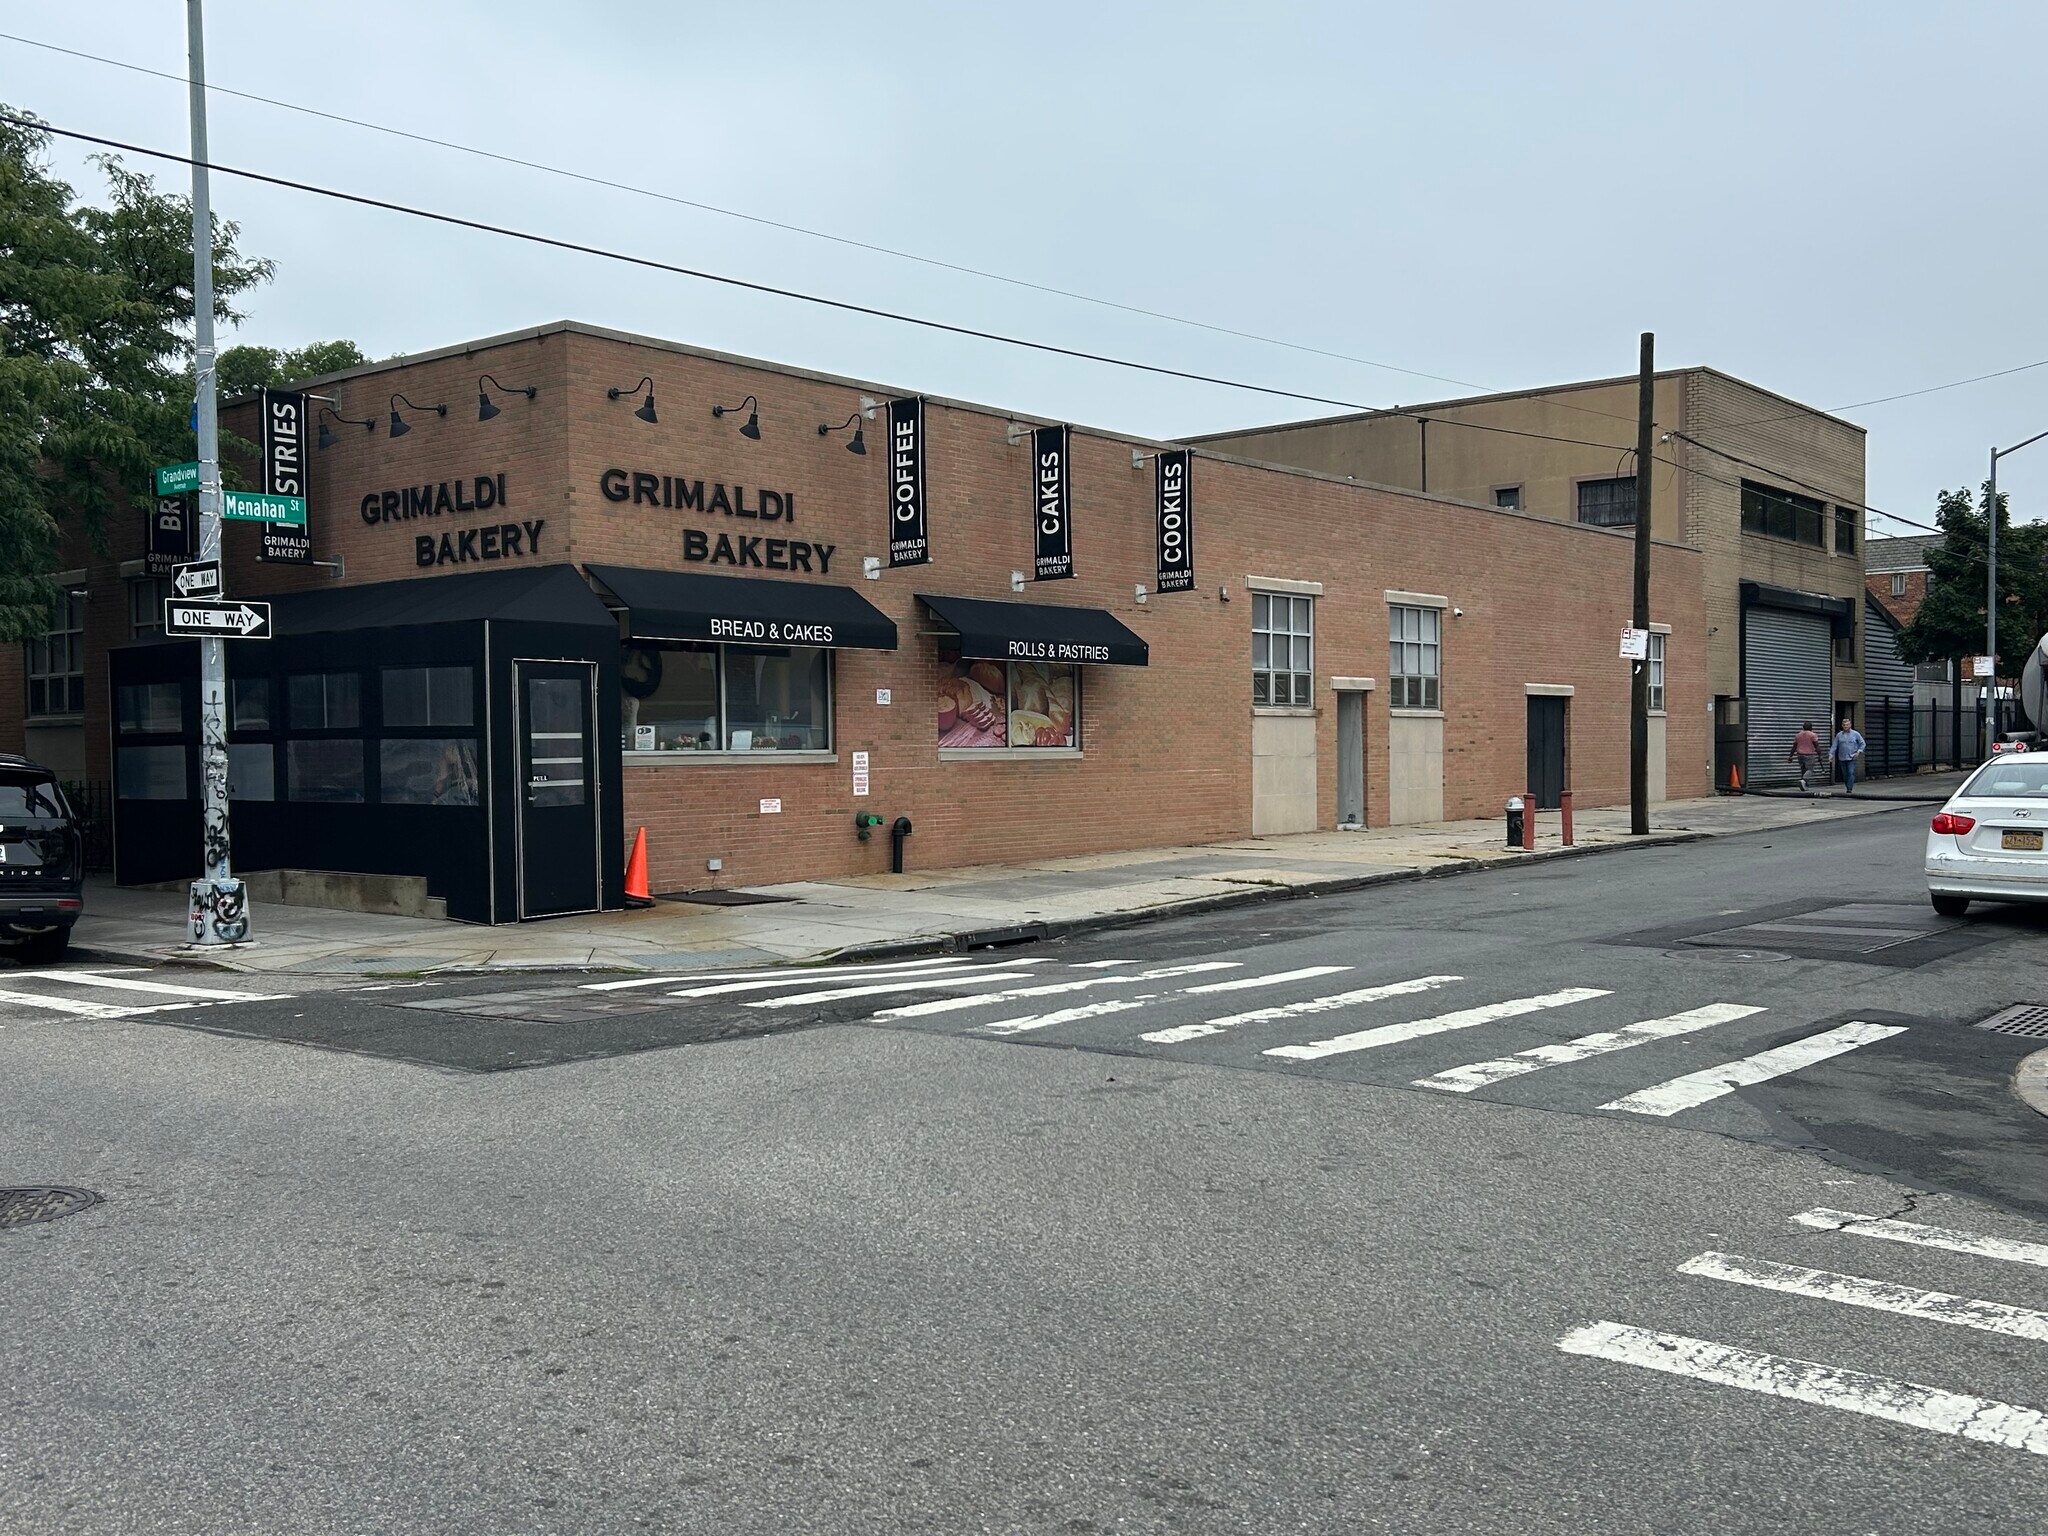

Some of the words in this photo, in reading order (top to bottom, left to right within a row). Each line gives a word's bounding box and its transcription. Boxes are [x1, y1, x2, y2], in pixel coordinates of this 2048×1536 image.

[272, 402, 299, 528] STRIES
[896, 420, 914, 521] COFFEE
[162, 467, 197, 484] Grandview
[361, 473, 506, 524] GRIMALDI
[601, 468, 794, 522] GRIMALDI
[1041, 451, 1059, 535] CAKES
[159, 500, 181, 531] BR
[226, 495, 286, 519] Menahan
[290, 499, 300, 511] St
[1163, 463, 1181, 563] COOKIES
[264, 536, 310, 548] GRIMALDI
[415, 520, 545, 566] BAKERY
[683, 529, 836, 573] BAKERY
[891, 539, 925, 552] GRIMALDI
[268, 547, 306, 558] BAKERY
[894, 549, 922, 561] BAKERY
[1036, 555, 1070, 567] GRIMALDI
[151, 563, 171, 573] BAK
[1038, 565, 1067, 576] BAKERY
[1159, 569, 1191, 581] GRIMALDI
[180, 574, 195, 588] ONE
[201, 572, 214, 586] WAY
[1161, 579, 1189, 589] BAKERY
[181, 611, 211, 625] ONE
[225, 613, 254, 627] WAY
[710, 618, 765, 638] BREAD
[769, 623, 779, 639] &
[783, 623, 833, 642] CAKES
[1008, 641, 1045, 657] ROLLS
[1048, 643, 1055, 657] &
[1058, 644, 1109, 660] PASTRIES
